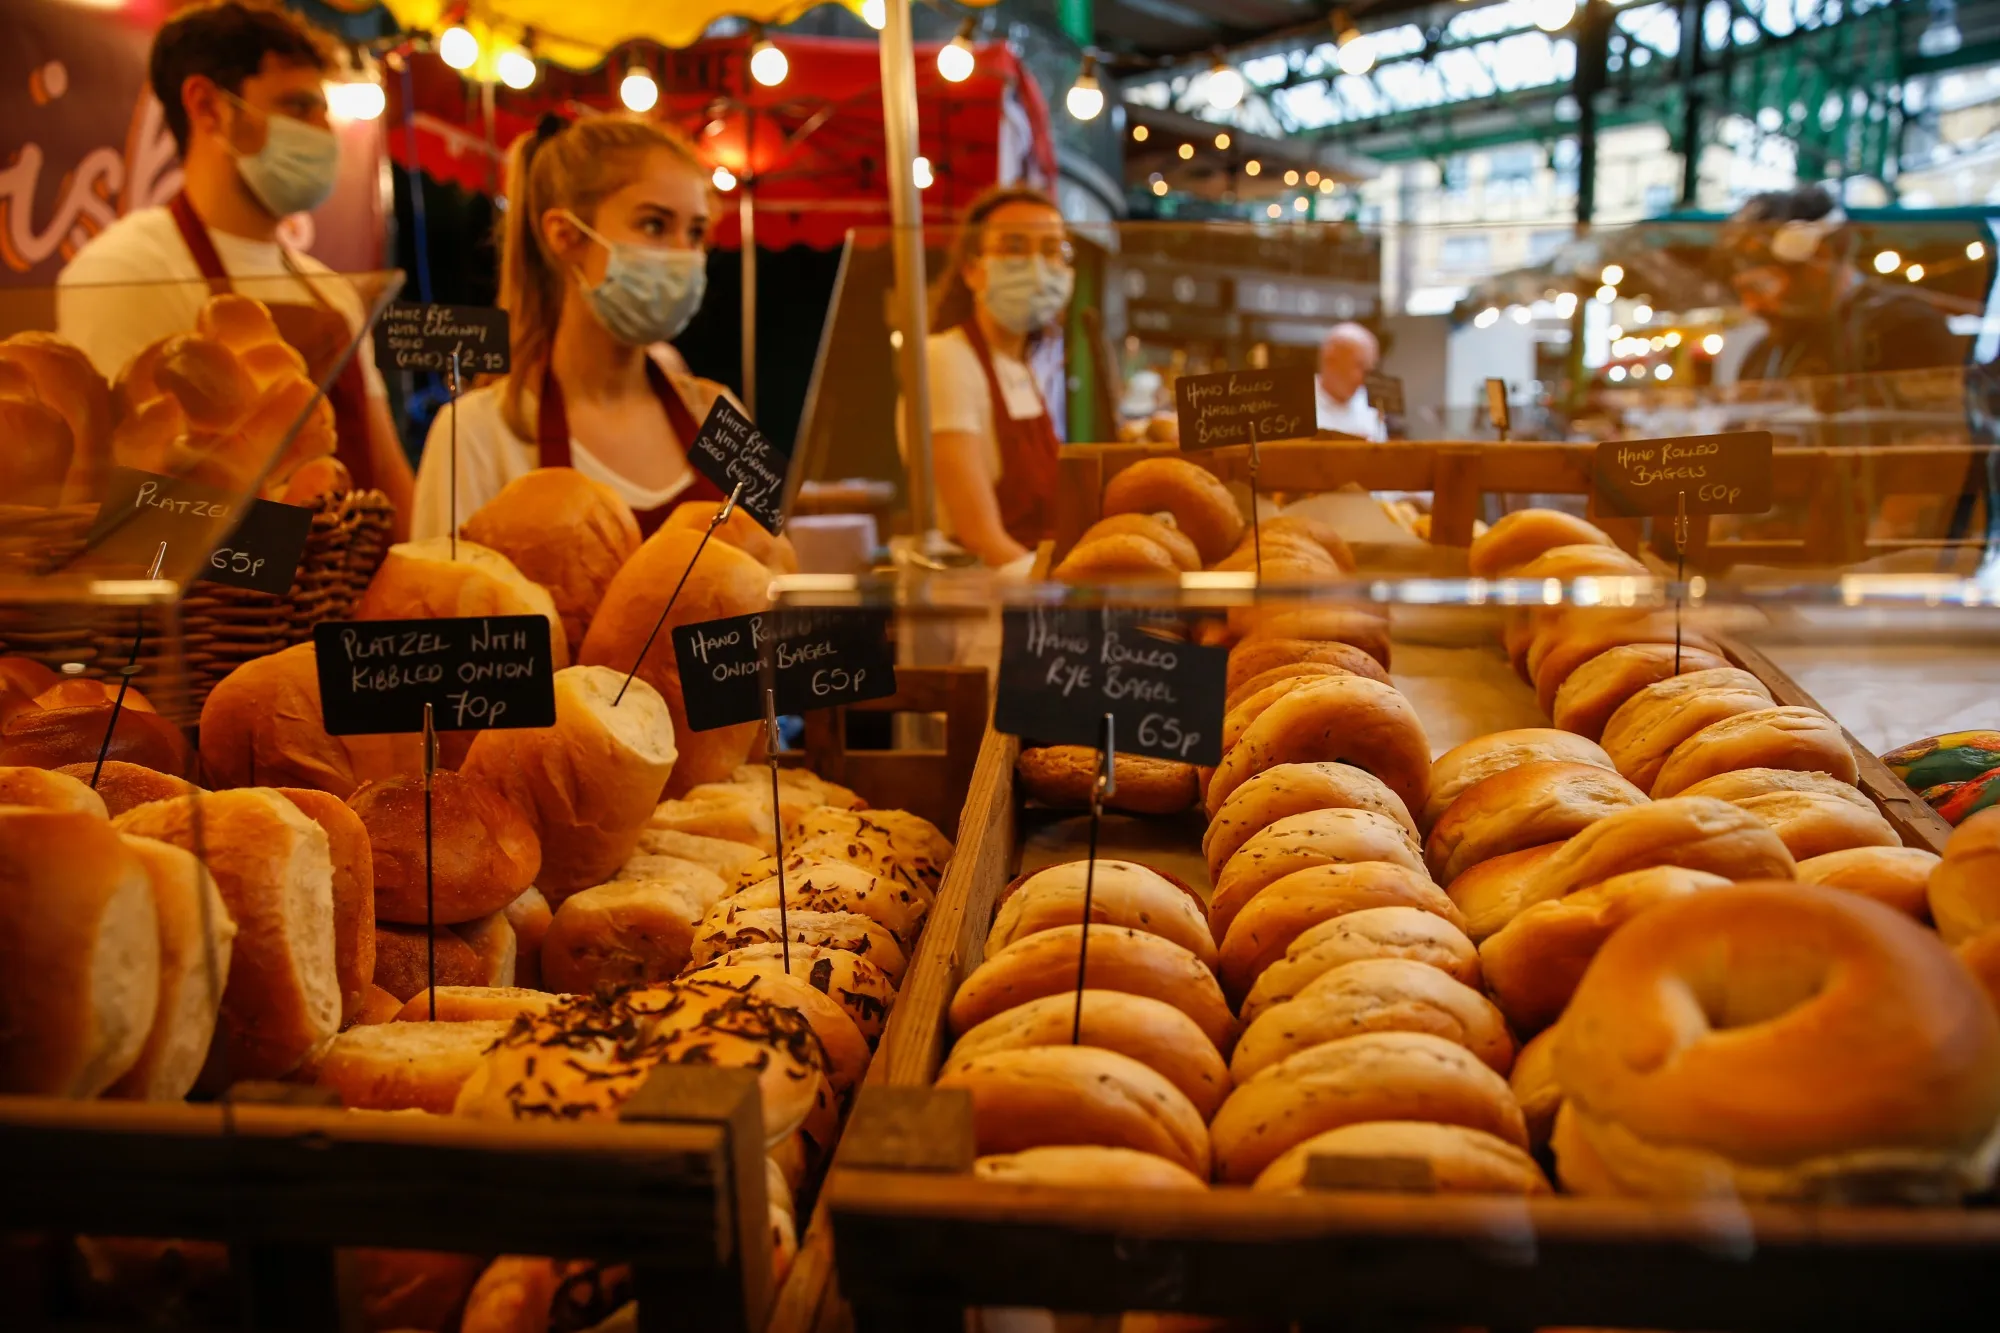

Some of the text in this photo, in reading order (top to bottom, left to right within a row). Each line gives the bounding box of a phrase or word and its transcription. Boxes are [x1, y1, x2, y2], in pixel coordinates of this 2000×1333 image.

[1195, 419, 1246, 444] BAGEL
[1617, 443, 1719, 469] HAND ROLLED
[1629, 464, 1707, 486] BAGELS
[340, 628, 451, 661] PLATZEL
[691, 629, 741, 664] HAND
[1027, 605, 1178, 670] HAND ROLLED
[352, 657, 535, 692] KIBBLED ONION
[712, 641, 838, 683] ONION BAGEL
[1046, 656, 1177, 704] RYE BAGEL
